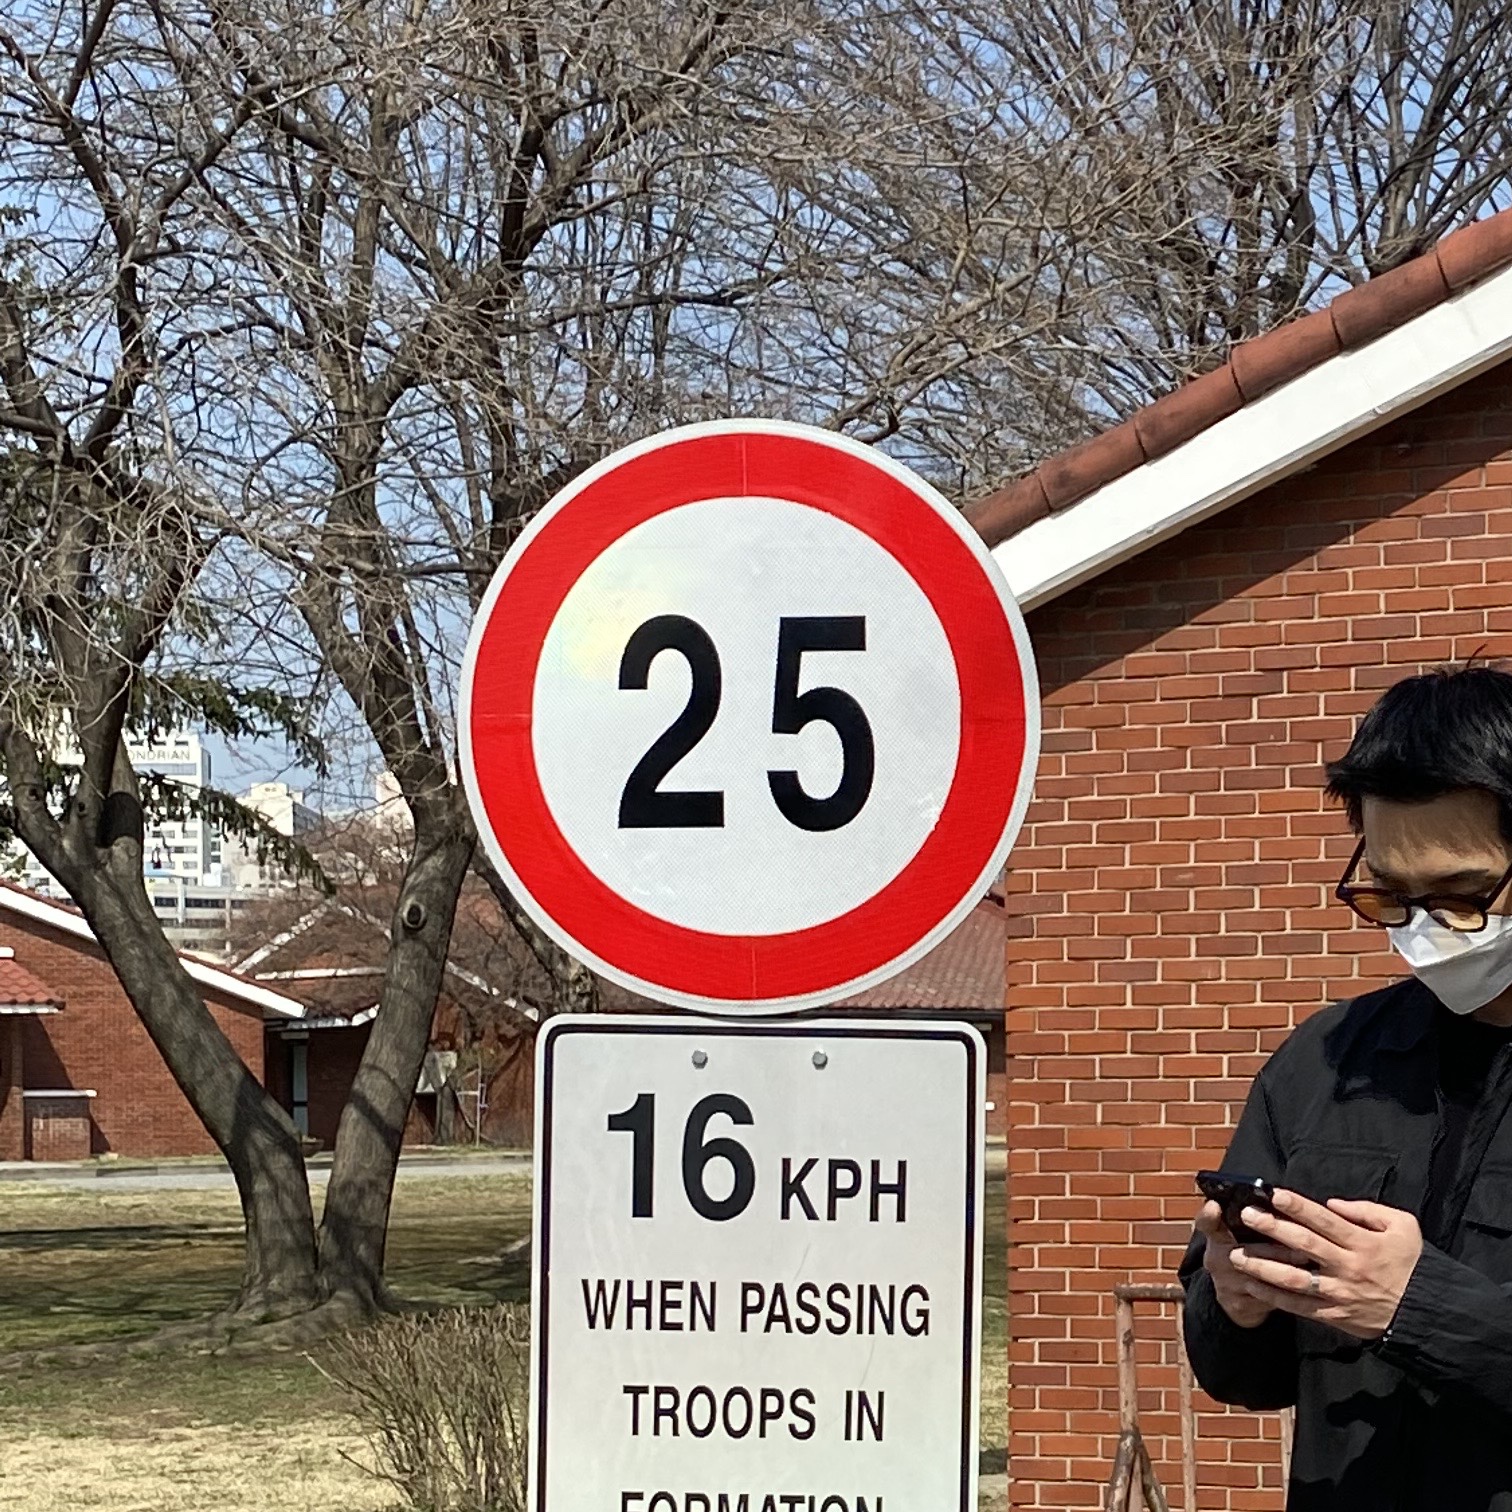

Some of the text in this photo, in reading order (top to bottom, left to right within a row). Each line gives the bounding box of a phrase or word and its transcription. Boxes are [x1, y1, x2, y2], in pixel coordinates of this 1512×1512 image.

[618, 614, 875, 832] 25
[607, 1092, 907, 1223] 16 KPH
[581, 1278, 930, 1337] WHEN PASSING
[622, 1384, 885, 1442] TROOPS IN
